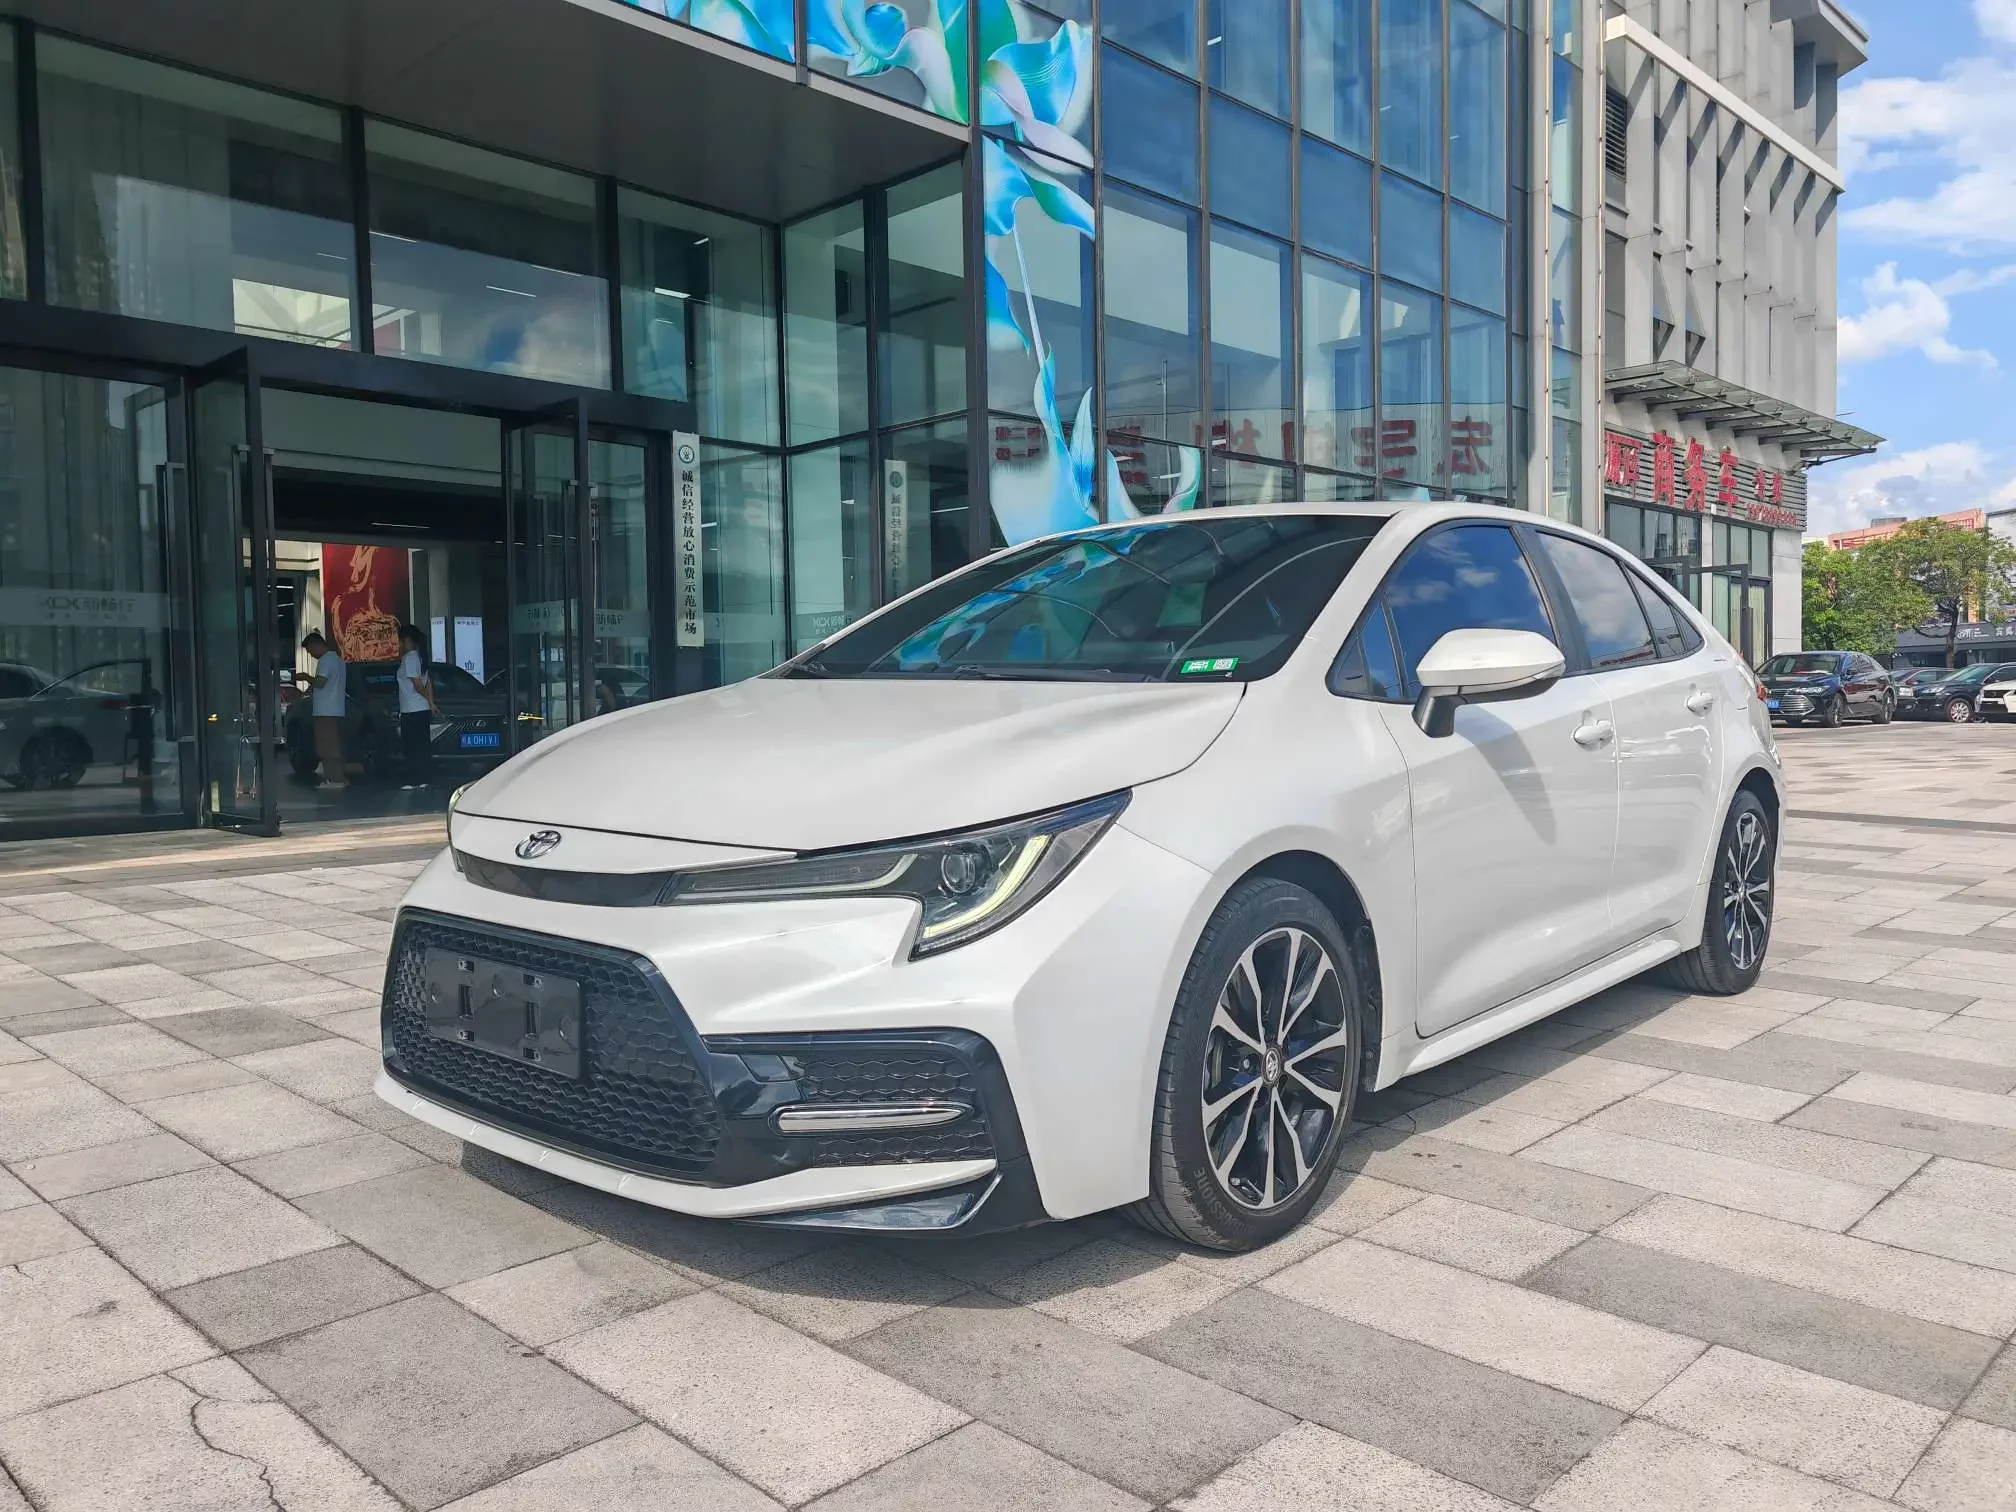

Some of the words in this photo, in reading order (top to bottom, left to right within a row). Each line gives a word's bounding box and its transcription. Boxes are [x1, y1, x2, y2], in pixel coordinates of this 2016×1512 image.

[680, 469, 697, 635] 诚信经营放心消费示范市场
